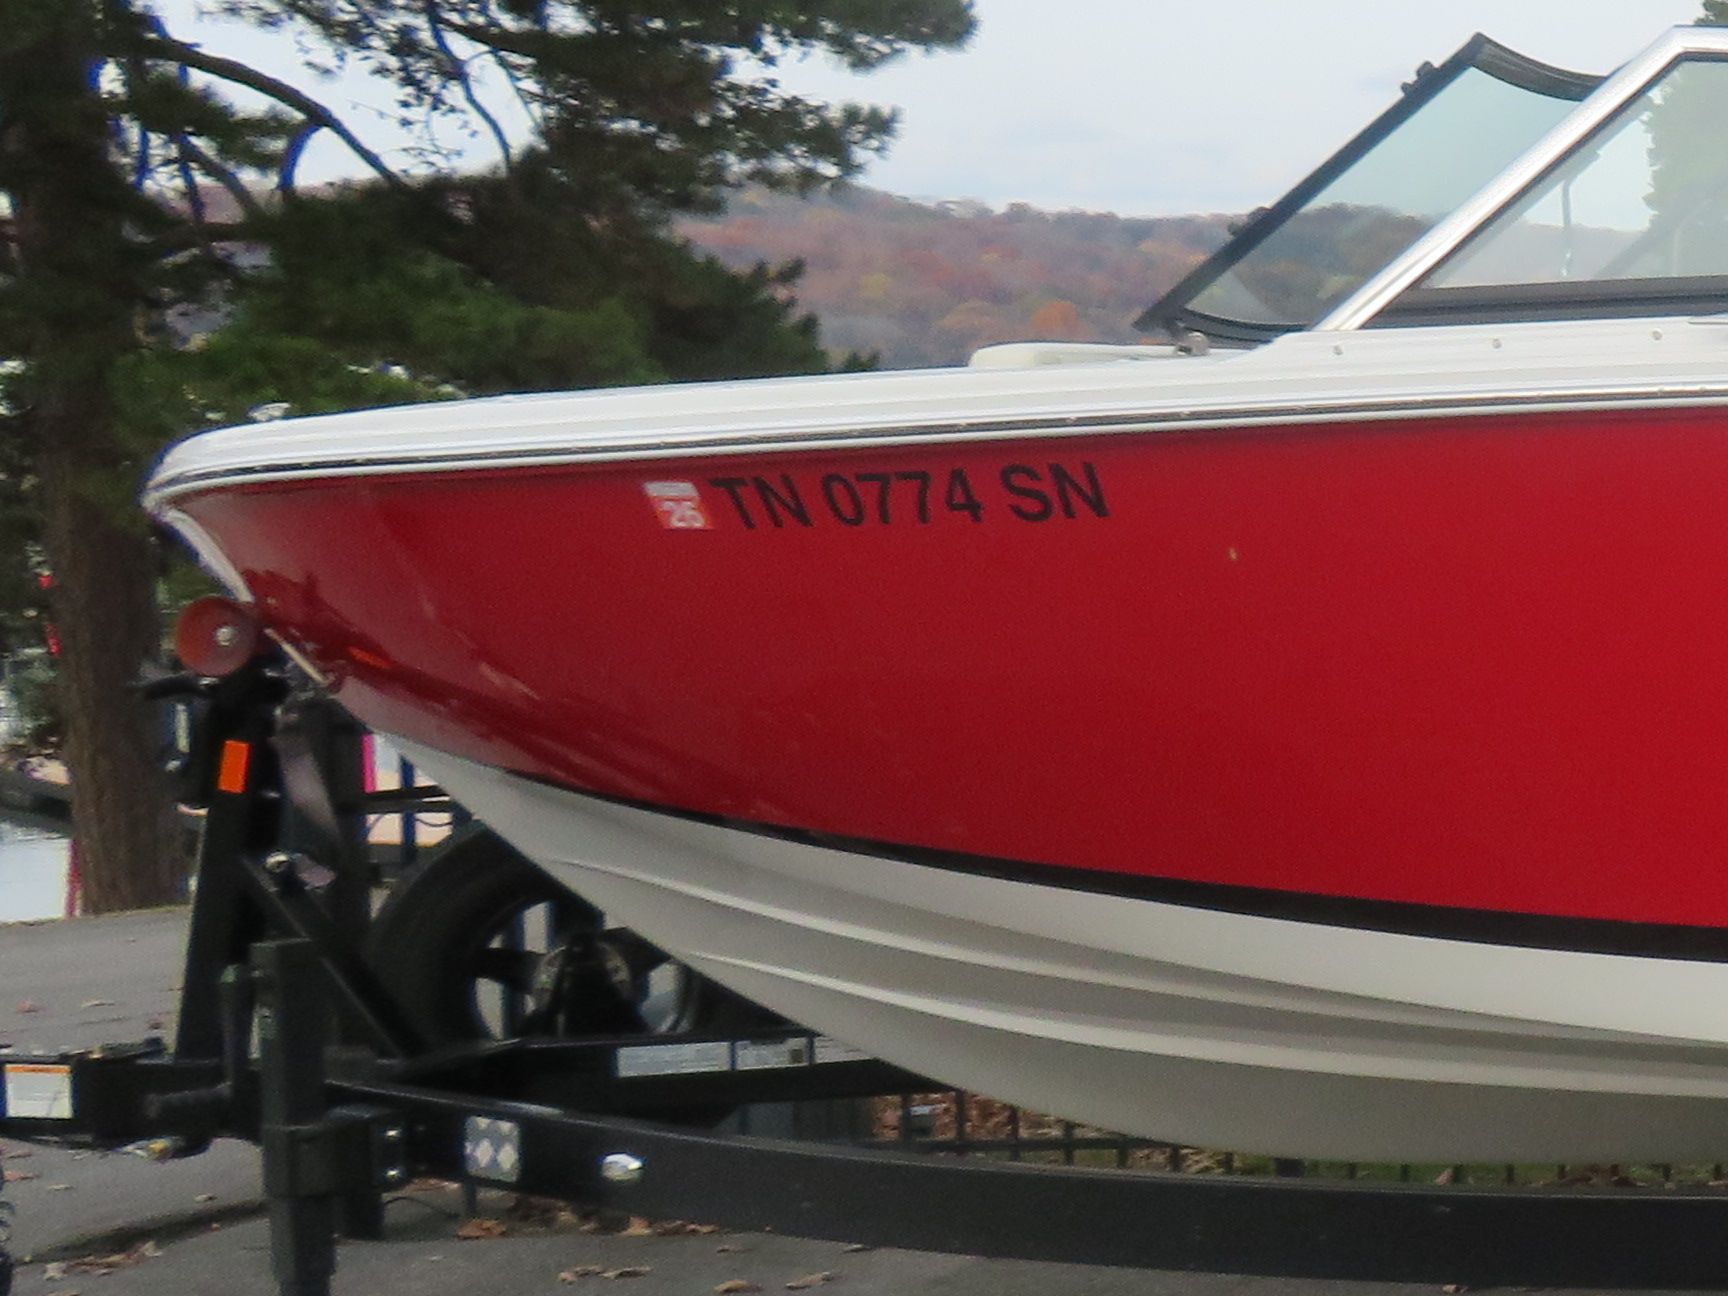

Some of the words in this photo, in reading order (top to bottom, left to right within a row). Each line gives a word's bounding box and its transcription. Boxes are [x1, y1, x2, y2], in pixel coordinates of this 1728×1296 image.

[709, 474, 813, 529] TN
[821, 467, 985, 526] 0774
[1001, 461, 1109, 522] SN
